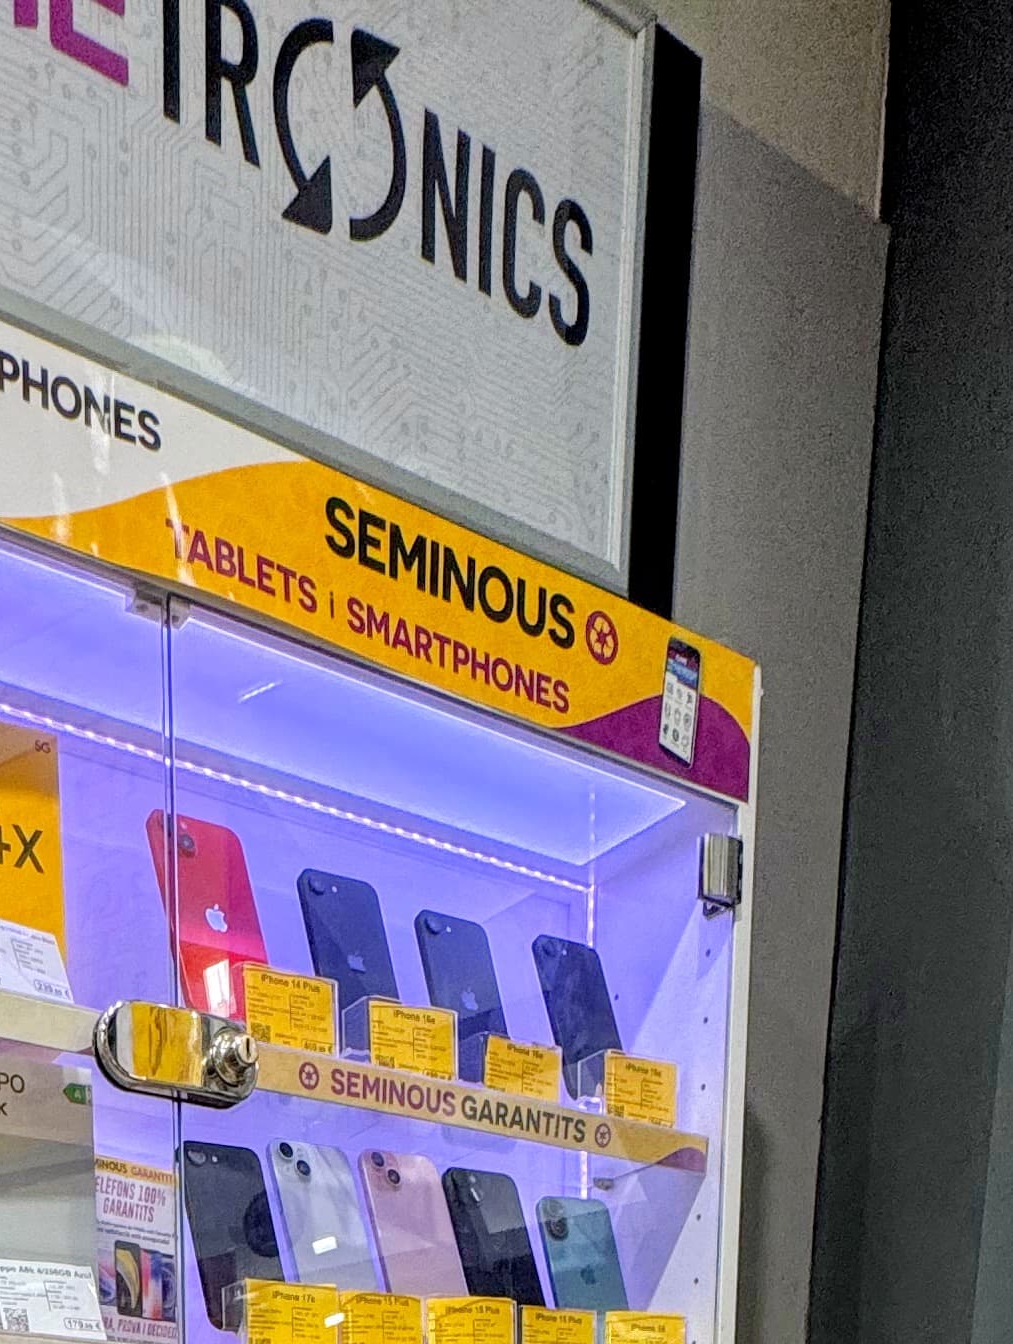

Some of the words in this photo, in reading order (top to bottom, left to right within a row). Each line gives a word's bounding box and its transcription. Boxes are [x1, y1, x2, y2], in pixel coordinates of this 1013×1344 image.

[14, 0, 594, 348] ETRONICS
[166, 518, 318, 613] TABLETS
[347, 599, 571, 715] SMARTPHONES
[324, 496, 577, 651] SEMINOUS
[330, 1068, 456, 1118] SEMINOUS
[461, 1095, 587, 1144] GARANTITS
[102, 1198, 154, 1223] GARANTITS
